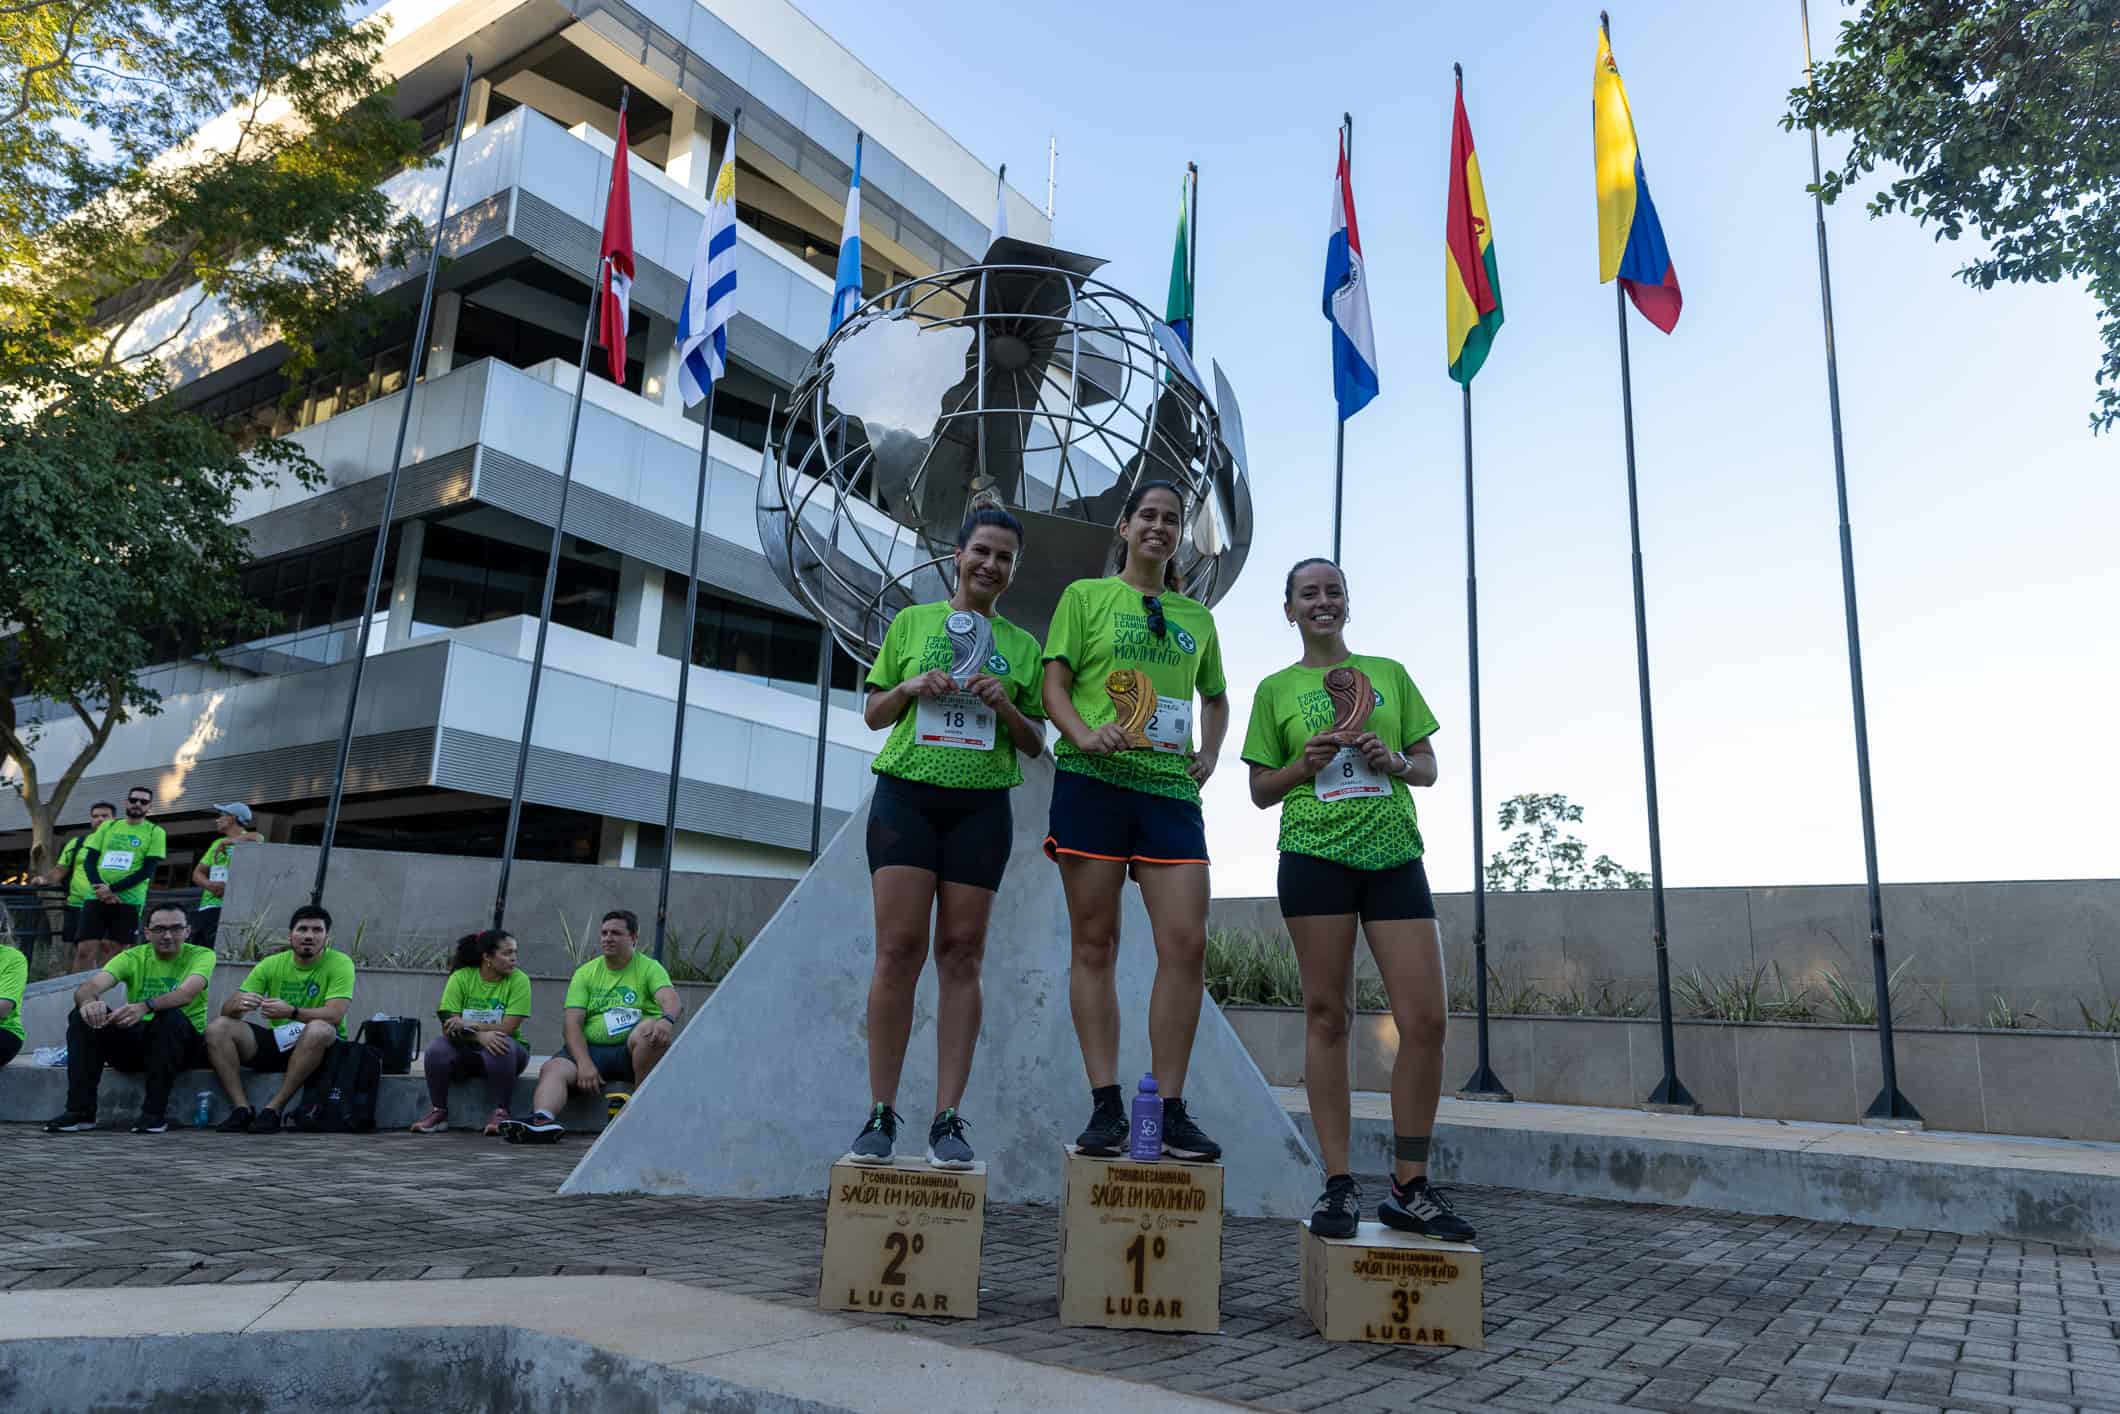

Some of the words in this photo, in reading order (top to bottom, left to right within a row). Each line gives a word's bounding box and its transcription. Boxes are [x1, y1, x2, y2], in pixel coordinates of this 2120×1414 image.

[1113, 644, 1181, 665] MOVIMENTO
[943, 711, 965, 728] 18
[1148, 715, 1158, 730] 2
[1342, 762, 1354, 778] 8
[869, 1171, 904, 1184] CORRIDA
[840, 1182, 880, 1204] SAÚDE
[884, 1187, 902, 1207] EM
[903, 1189, 976, 1210] MOVIMENTO
[1090, 1180, 1126, 1208] SAÚDE
[1127, 1185, 1143, 1209] EM
[1144, 1187, 1207, 1212] MOVIMENTO
[881, 1232, 924, 1286] 2º
[1126, 1235, 1166, 1294] 1º
[849, 1289, 949, 1311] LUGAR
[1106, 1296, 1183, 1319] LUGAR
[1392, 1289, 1420, 1324] 3º
[1365, 1324, 1445, 1343] LUGAR
